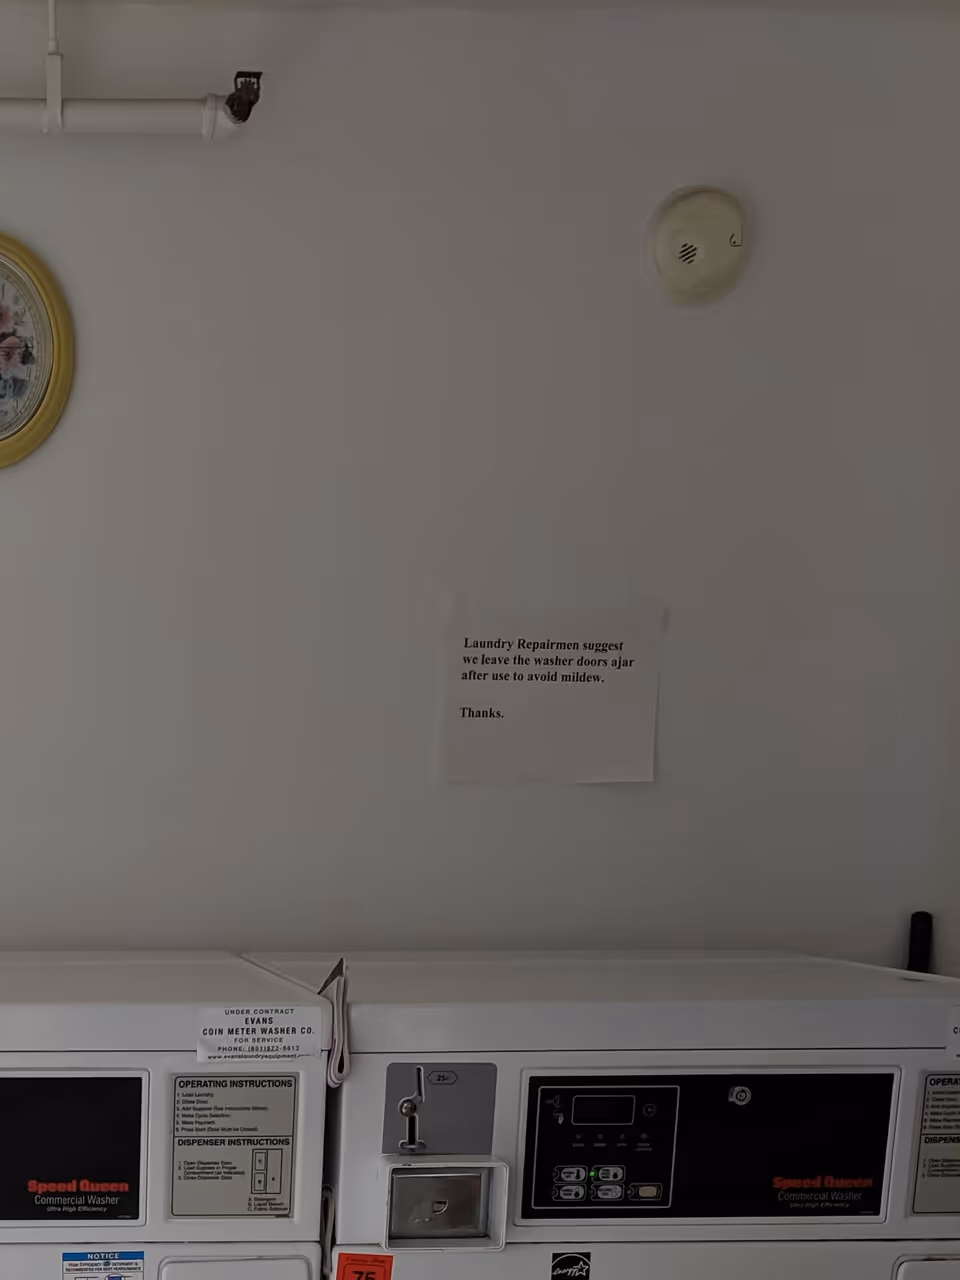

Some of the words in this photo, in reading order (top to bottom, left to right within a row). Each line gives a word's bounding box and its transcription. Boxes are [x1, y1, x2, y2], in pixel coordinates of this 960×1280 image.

[464, 638, 513, 652] Laundry
[517, 639, 579, 652] Repairmen
[582, 641, 624, 653] suggest
[463, 656, 478, 665] we
[481, 654, 510, 666] leave
[513, 655, 531, 666] the
[534, 656, 574, 667] washer
[577, 656, 608, 668] doors
[611, 658, 635, 670] ajar
[462, 670, 489, 681] after
[492, 672, 510, 681] use
[513, 672, 524, 681] to
[527, 672, 557, 682] avoid
[561, 672, 605, 683] mildew.
[460, 707, 504, 719] Thanks.
[261, 1027, 297, 1035] WASHER
[179, 1080, 228, 1088] OPERATING
[230, 1080, 292, 1088] INSTRUCTIONS
[228, 1138, 290, 1146] INSTRUCTIONS
[28, 1179, 77, 1194] Speed
[80, 1178, 129, 1192] Queen
[34, 1195, 84, 1205] Commercial
[87, 1195, 120, 1205] Washer
[778, 1191, 828, 1201] Commercial
[830, 1191, 863, 1201] Washer
